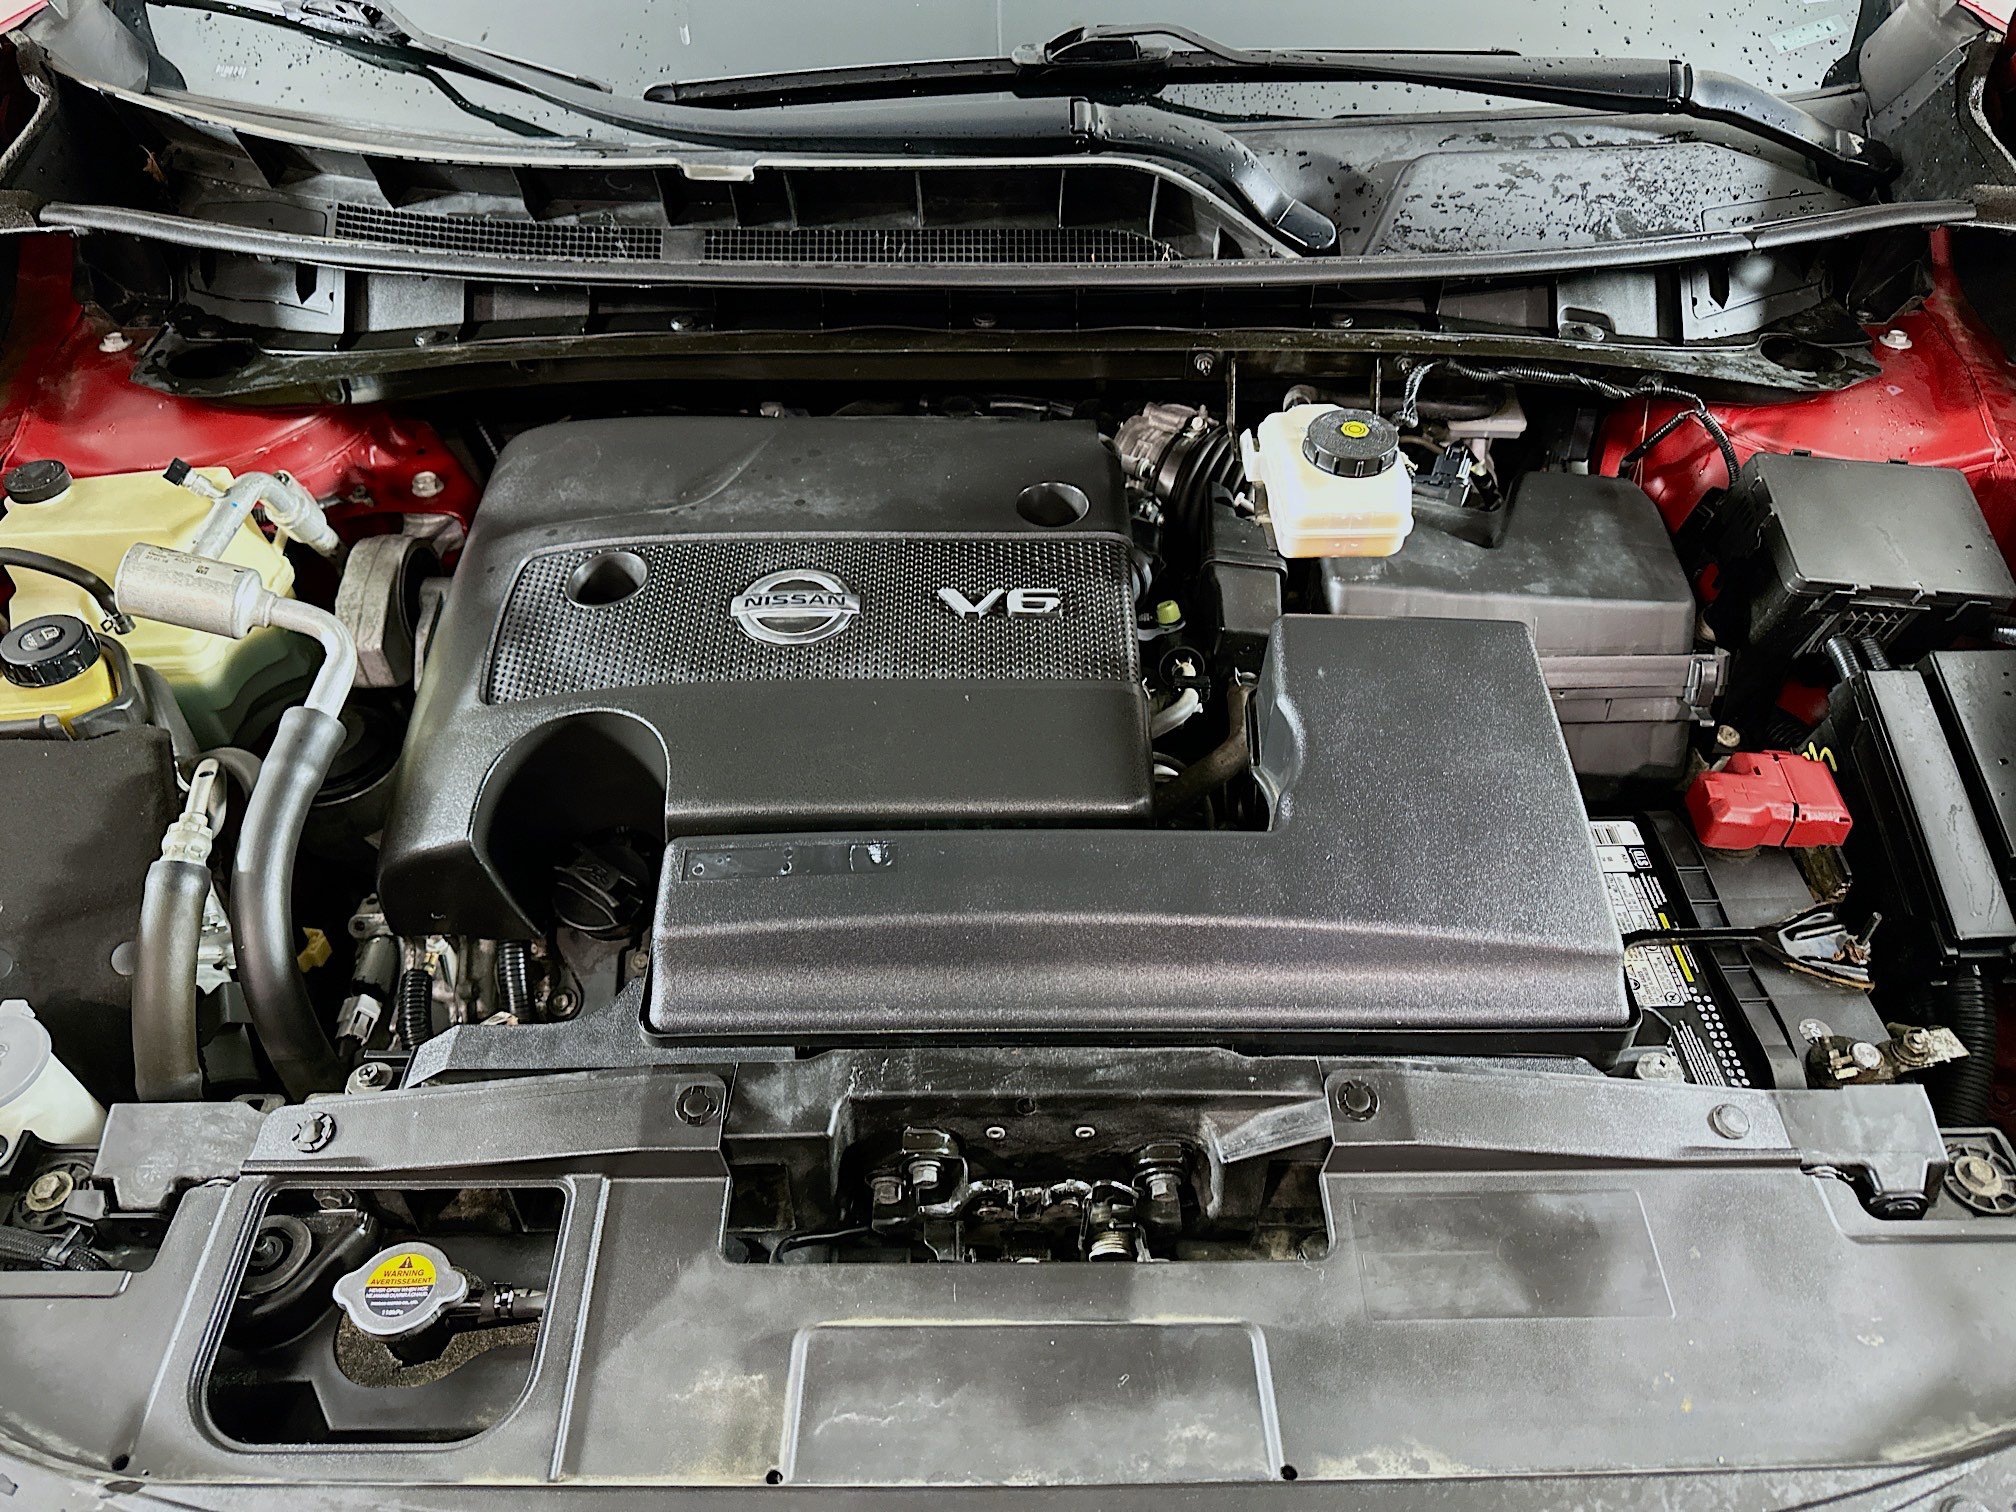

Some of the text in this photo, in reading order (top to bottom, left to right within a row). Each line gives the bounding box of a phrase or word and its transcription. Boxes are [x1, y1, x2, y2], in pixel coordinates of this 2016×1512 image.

[744, 594, 847, 607] NISSAN
[937, 587, 1062, 620] V6
[383, 1269, 425, 1277] WARNING
[370, 1277, 433, 1285] AVERTISSEMENT
